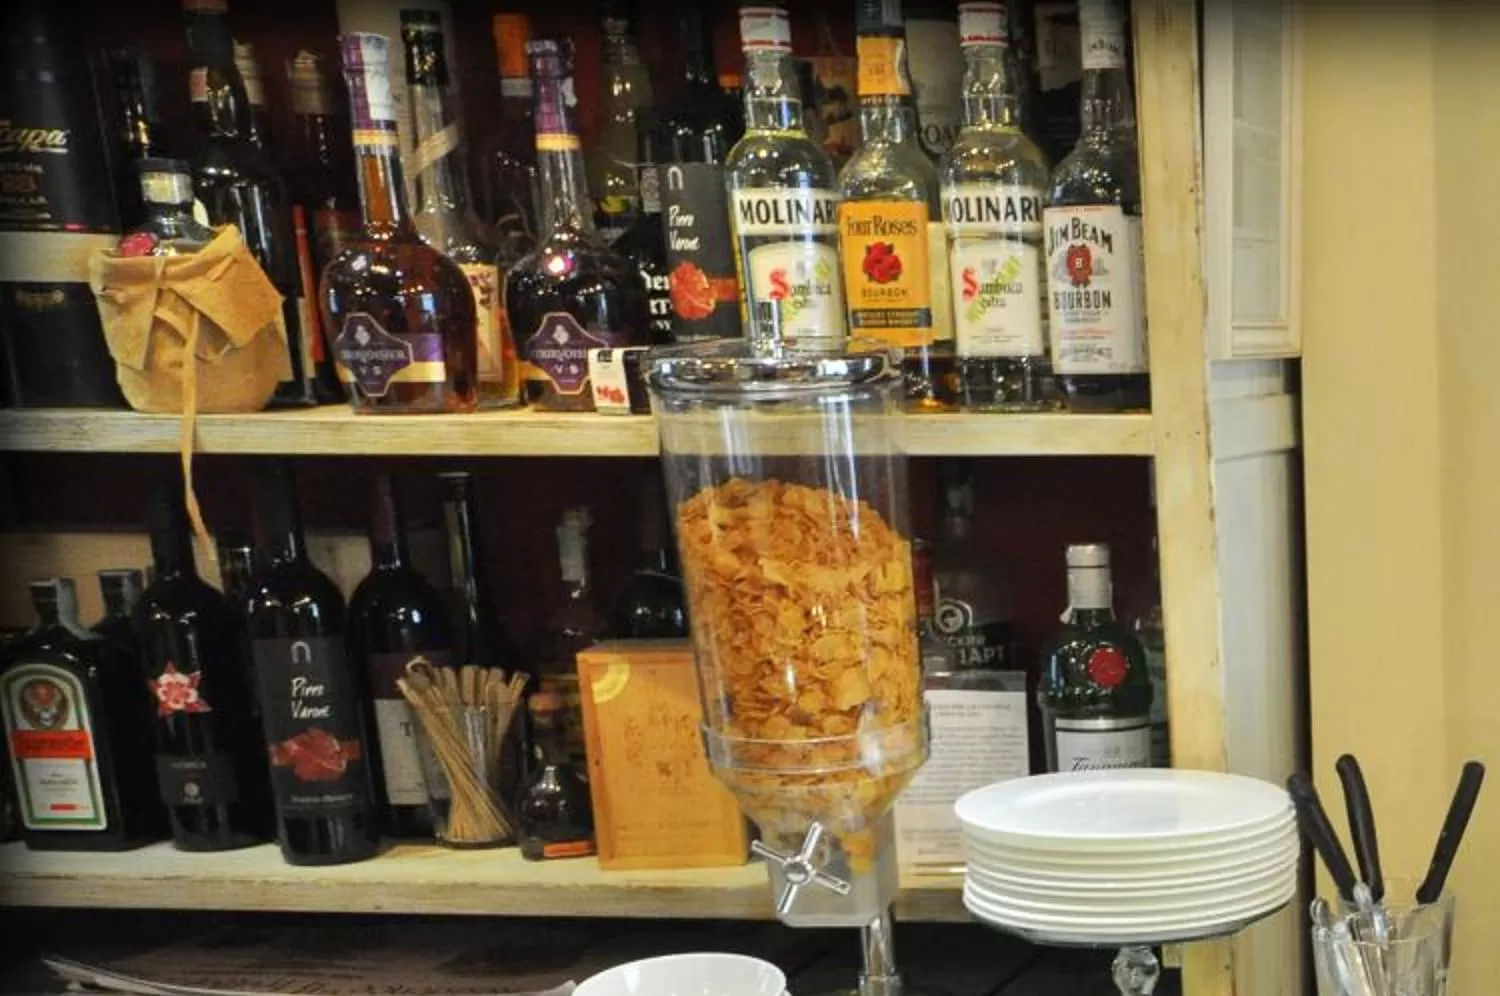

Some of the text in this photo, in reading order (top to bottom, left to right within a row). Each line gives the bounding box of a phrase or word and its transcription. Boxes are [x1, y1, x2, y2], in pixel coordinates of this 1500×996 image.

[738, 199, 834, 225] MOLINAR
[1071, 217, 1114, 255] BEAM
[1053, 290, 1112, 310] BOURBON
